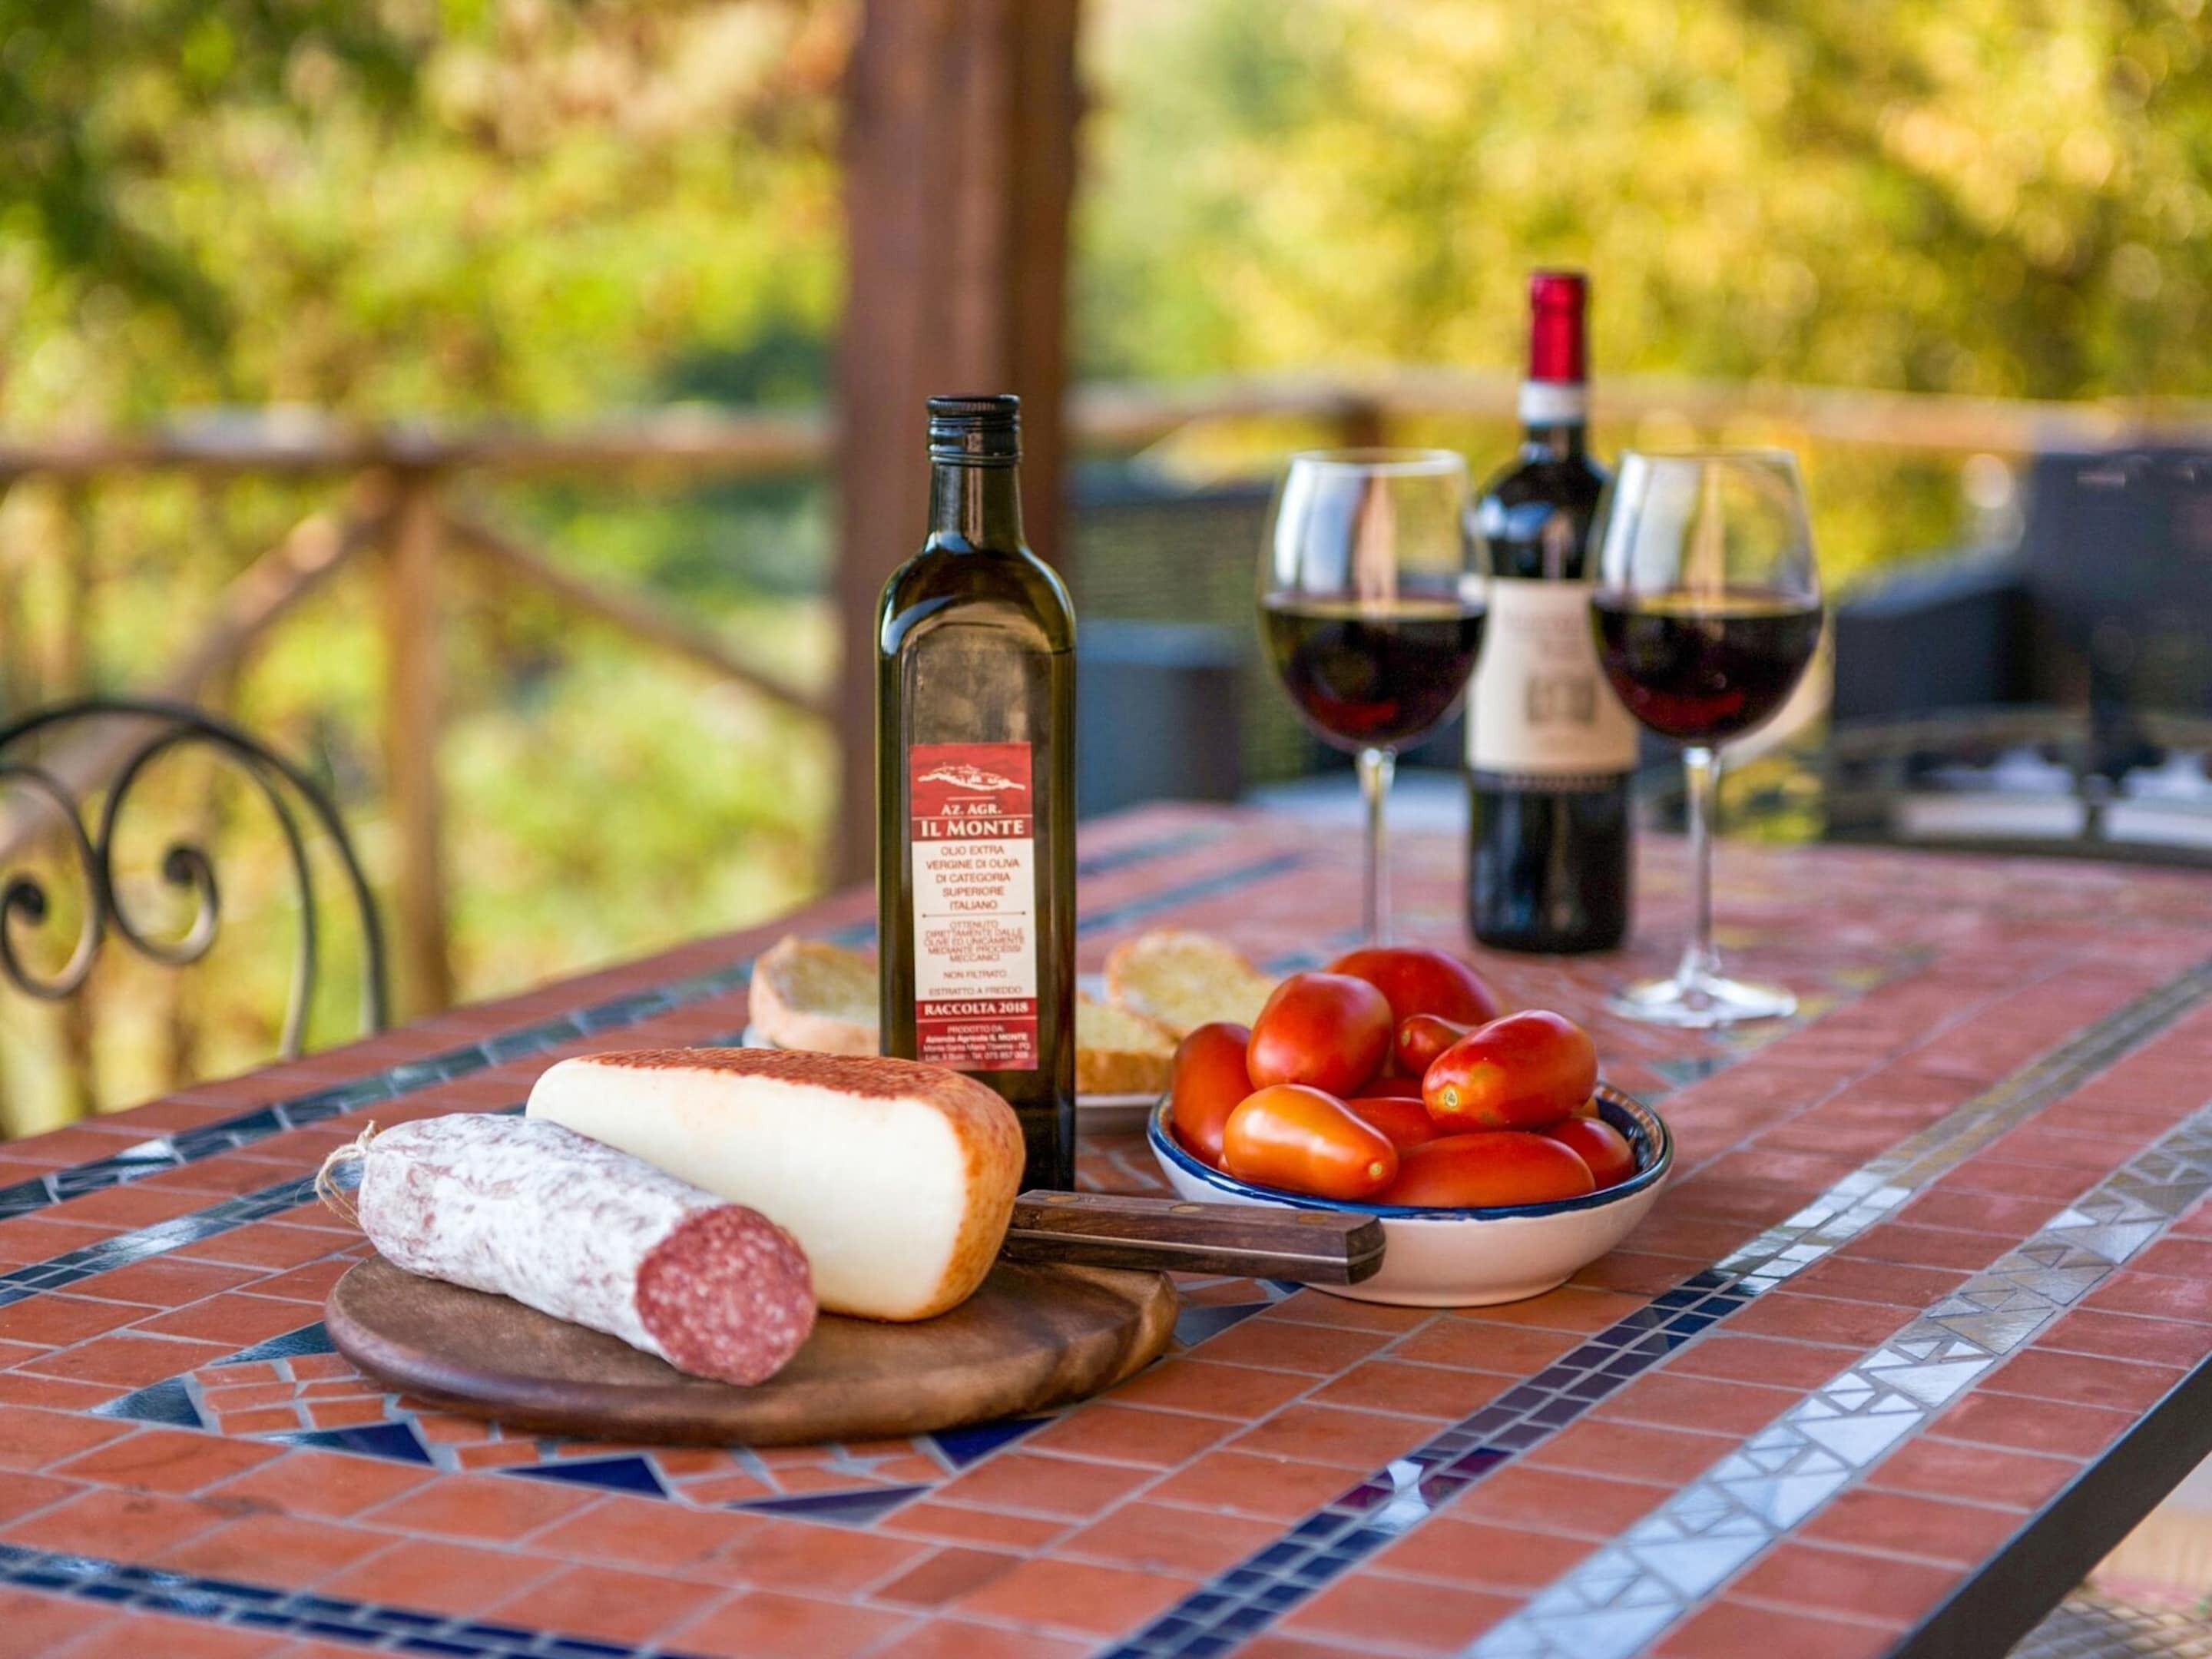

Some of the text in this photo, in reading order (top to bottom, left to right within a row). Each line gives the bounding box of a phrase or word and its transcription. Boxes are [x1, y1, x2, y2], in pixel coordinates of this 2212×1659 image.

[942, 804, 1002, 816] AZ. AGR.
[921, 820, 1024, 836] IL MONTE
[941, 845, 1004, 856] OLIO EXTRA
[926, 860, 972, 869] VERGINE
[989, 859, 1019, 868] OLIVA
[935, 873, 1011, 883] DI CATEGORIA
[943, 886, 1005, 897] SUPERIORE
[950, 900, 998, 910] ITALIANO
[924, 1002, 1028, 1015] RACCOLTA 2018
